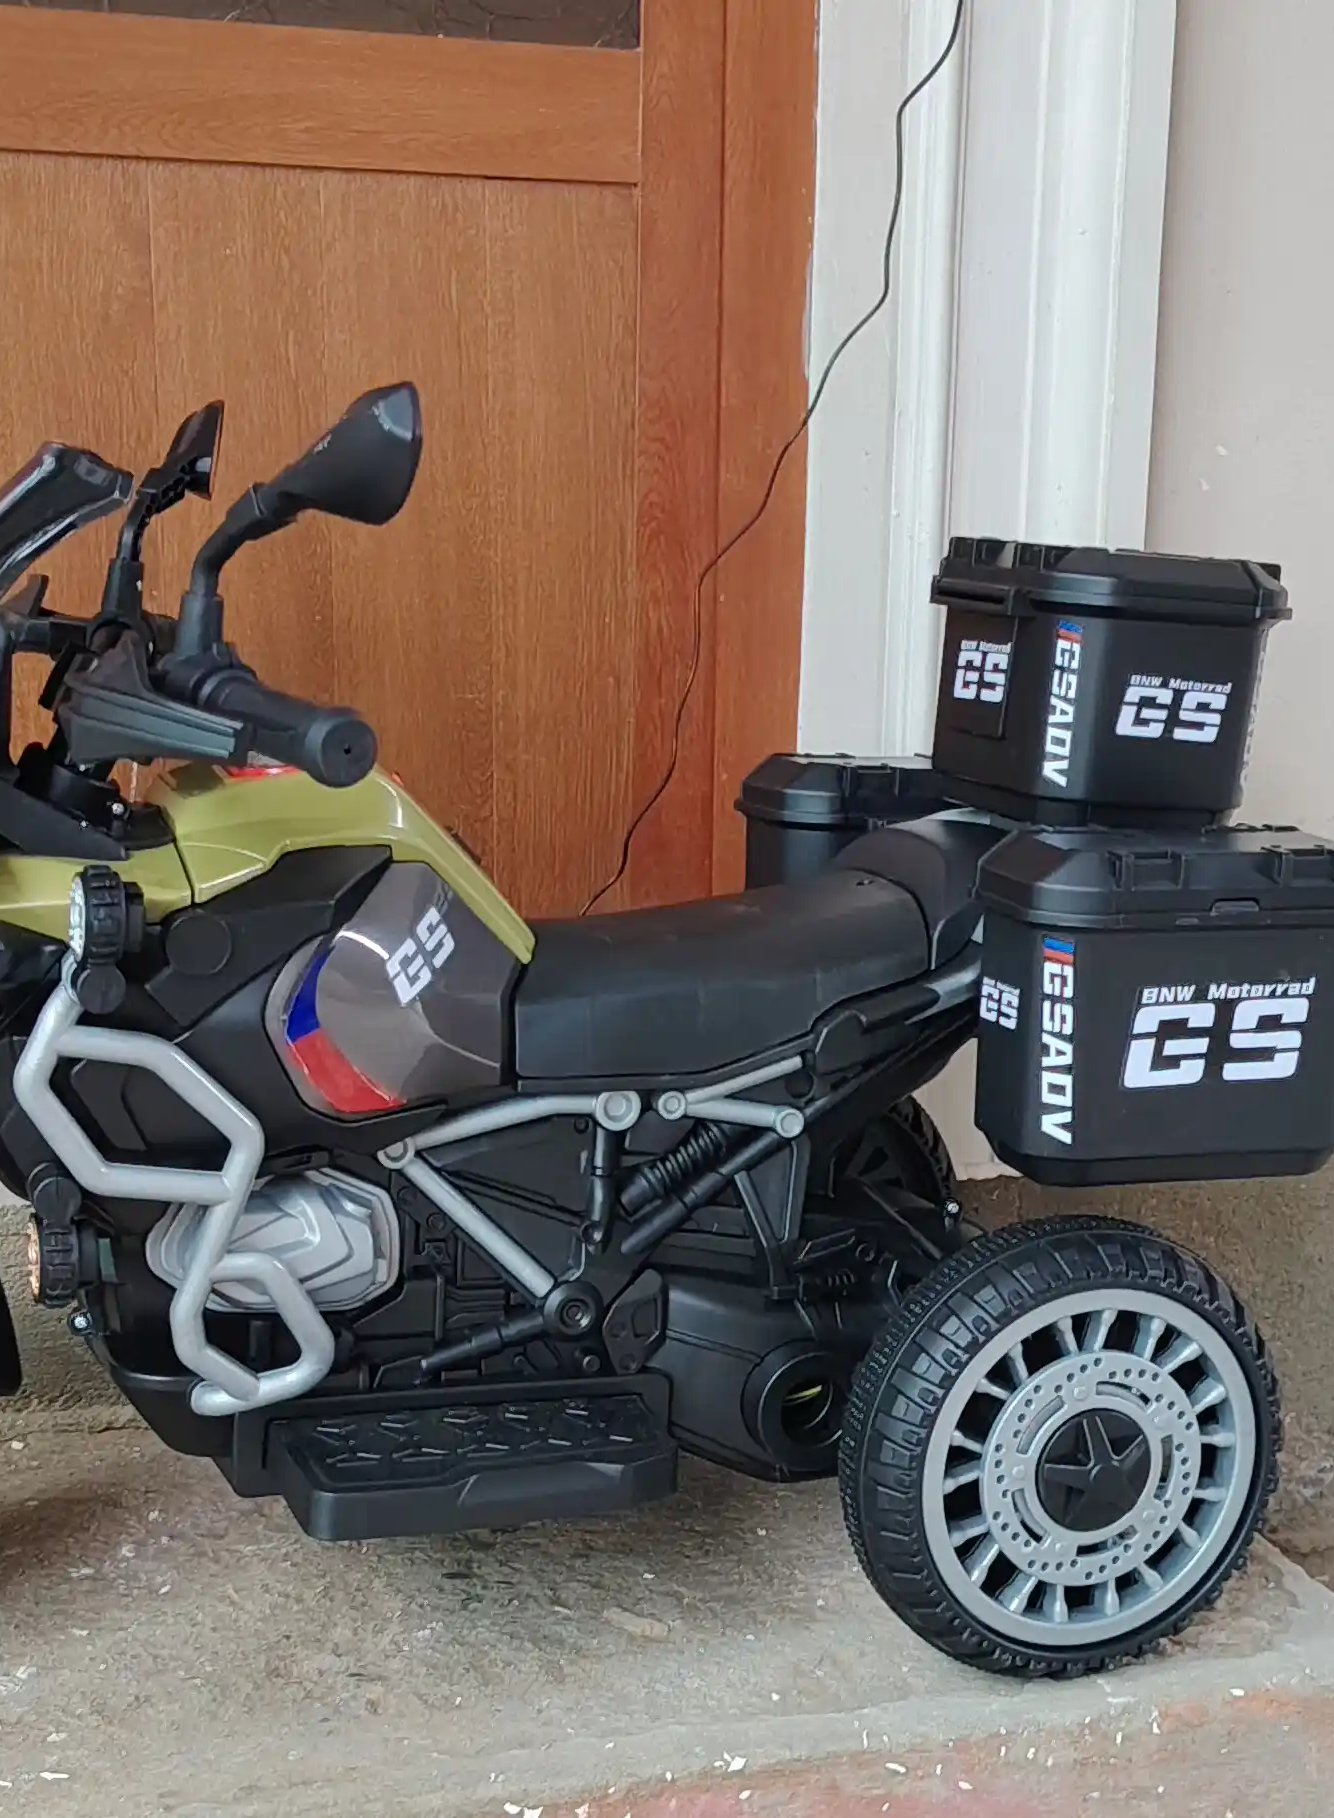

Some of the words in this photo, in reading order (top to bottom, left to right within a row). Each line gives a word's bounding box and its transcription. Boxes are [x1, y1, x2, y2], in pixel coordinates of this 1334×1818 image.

[953, 650, 1009, 703] GS
[1168, 677, 1233, 694] Motorrad
[1042, 638, 1081, 788] GSADV
[1115, 686, 1228, 743] GS
[385, 906, 456, 1006] GS
[979, 984, 1020, 1030] GS
[1140, 984, 1196, 1004] BNW
[1206, 976, 1316, 1000] Motorrad
[1040, 961, 1075, 1145] GSADV
[1122, 997, 1310, 1089] GS
